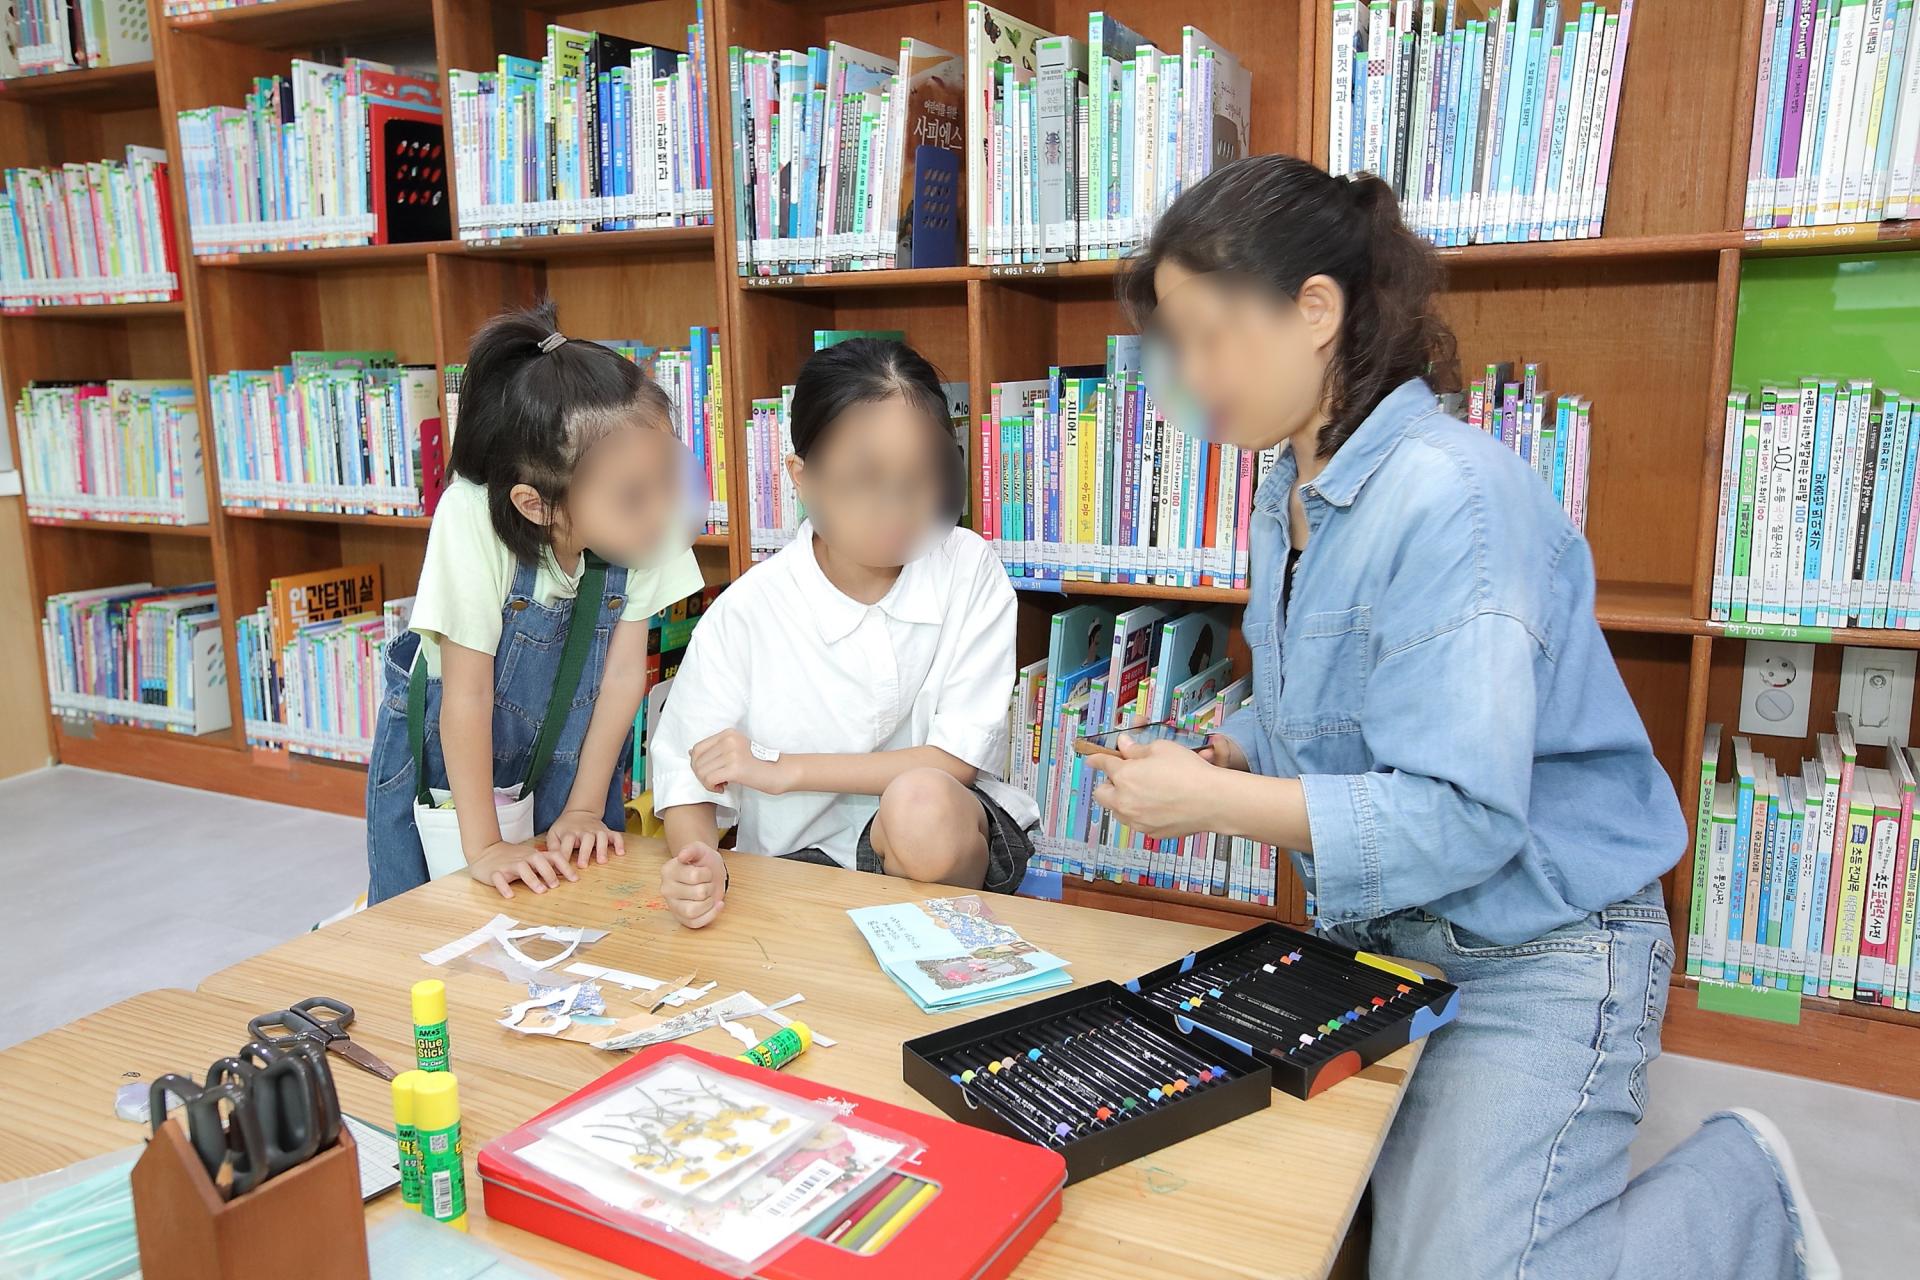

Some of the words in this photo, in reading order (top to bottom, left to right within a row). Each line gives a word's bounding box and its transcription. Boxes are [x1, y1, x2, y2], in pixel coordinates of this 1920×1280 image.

[1337, 44, 1349, 73] 탈것
[1336, 77, 1348, 102] 백과
[913, 115, 963, 151] 사피엔스
[1833, 226, 1856, 236] 699
[1004, 266, 1023, 275] 495.1
[1031, 265, 1046, 274] 499
[758, 278, 770, 286] 456
[777, 277, 793, 285] 471.9
[1801, 389, 1813, 422] 어린이를
[1067, 400, 1076, 446] 지니어스!
[1801, 424, 1809, 438] 위한
[1882, 411, 1893, 439] 동네에서
[1761, 438, 1769, 450] 국어
[1772, 445, 1792, 471] 101
[1798, 439, 1810, 475] 헷갈리는
[1758, 487, 1766, 503] 우리말
[1773, 485, 1786, 502] 초등
[1795, 476, 1807, 502] 우리말
[1812, 472, 1825, 506] 맞춤법
[1739, 503, 1750, 538] 그림사전
[1757, 505, 1765, 519] 100
[1795, 504, 1806, 523] 100
[1808, 509, 1823, 549] 띄어쓰기
[1769, 524, 1781, 558] 질문사전
[289, 578, 356, 617] 인간답게
[359, 575, 374, 603] 살
[1745, 626, 1765, 636] 700
[1780, 627, 1798, 637] 713
[1753, 830, 1760, 841] 국어
[1850, 847, 1862, 865] 초등
[1846, 865, 1861, 893] 전과목
[1872, 872, 1889, 889] 초등
[1907, 872, 1916, 890] 어린이
[1711, 873, 1726, 905] 통일사전
[1869, 889, 1888, 918] 표현력
[1905, 890, 1914, 909] 중국어
[1904, 910, 1913, 924] 1교시
[1868, 918, 1882, 938] 사전
[419, 1029, 441, 1037] AMOS
[417, 1038, 443, 1049] Glue
[418, 1046, 444, 1058] Stick
